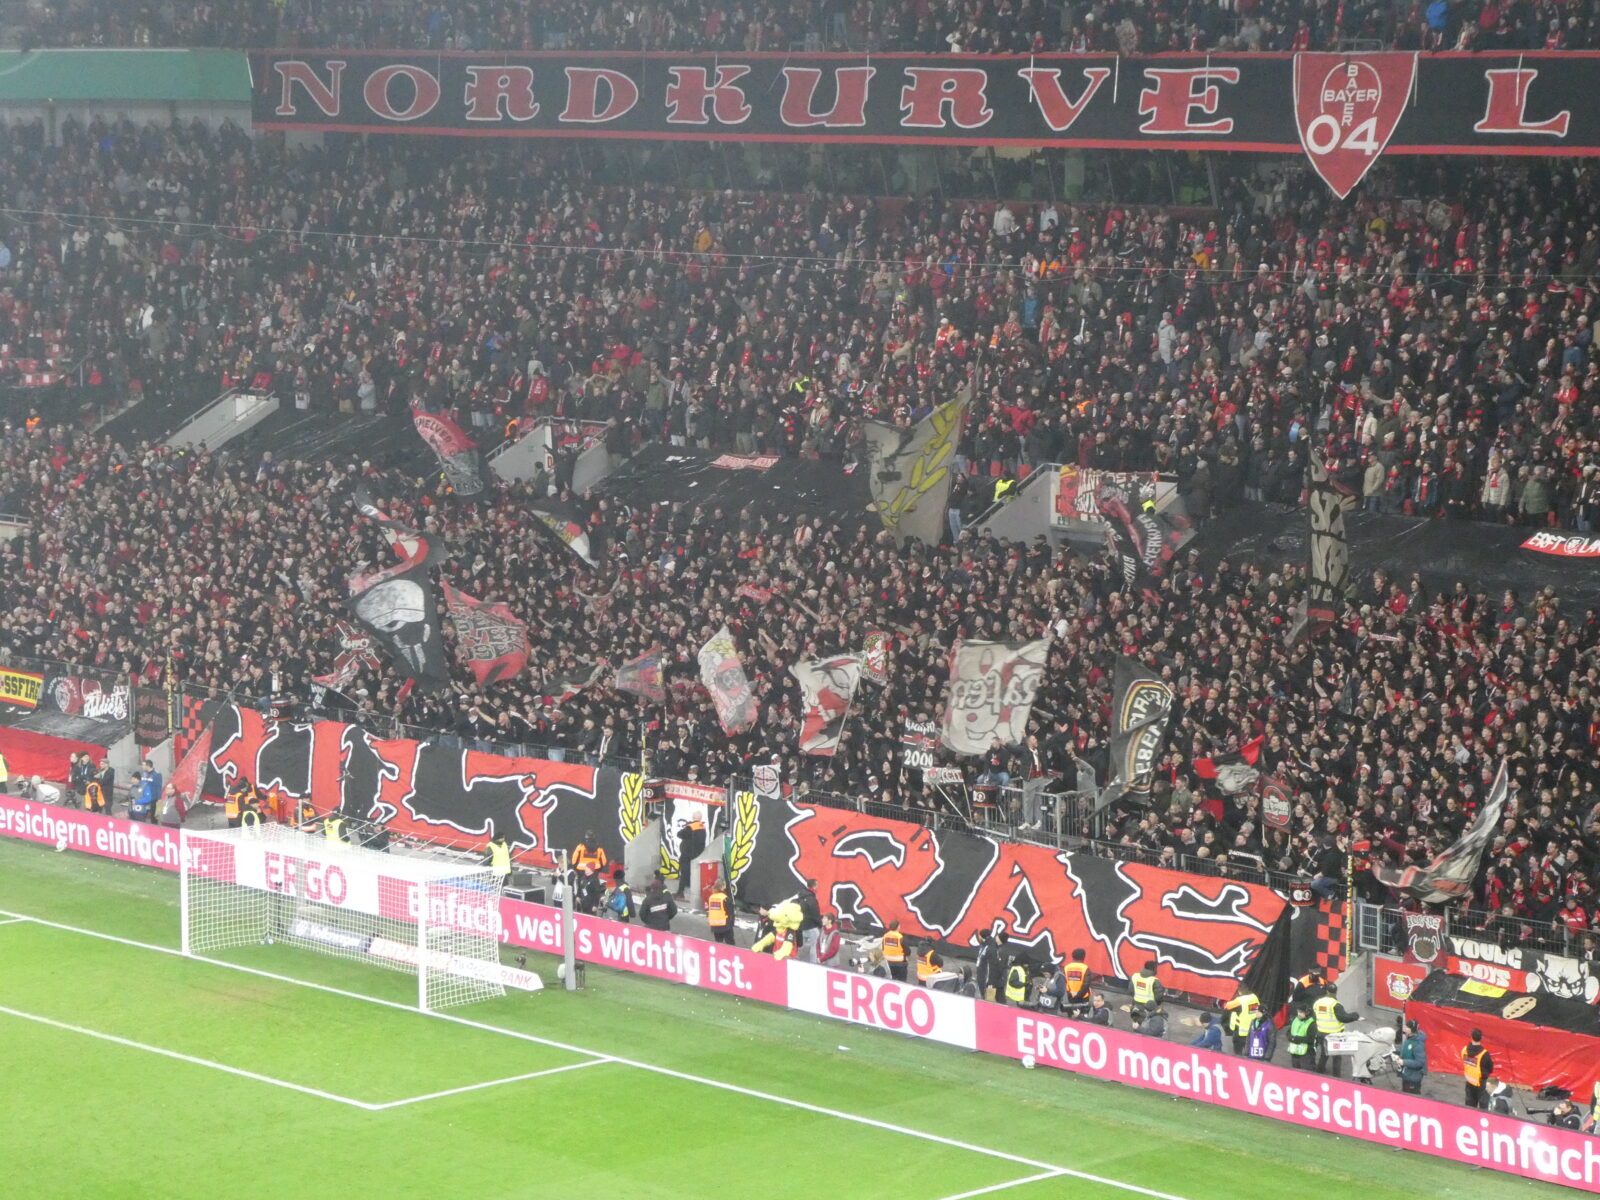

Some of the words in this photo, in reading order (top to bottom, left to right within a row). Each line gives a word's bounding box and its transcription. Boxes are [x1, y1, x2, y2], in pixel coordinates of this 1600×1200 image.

[274, 61, 1240, 134] NORDKURVE
[1323, 89, 1378, 103] BAYER
[1306, 113, 1380, 156] 04
[265, 852, 347, 905] ERGO
[598, 925, 701, 985] wichtig
[708, 945, 753, 992] ist.
[825, 970, 935, 1036] ERGO
[1016, 1016, 1108, 1070] ERGO
[1118, 1047, 1230, 1099] macht
[1238, 1065, 1443, 1149] Versichern
